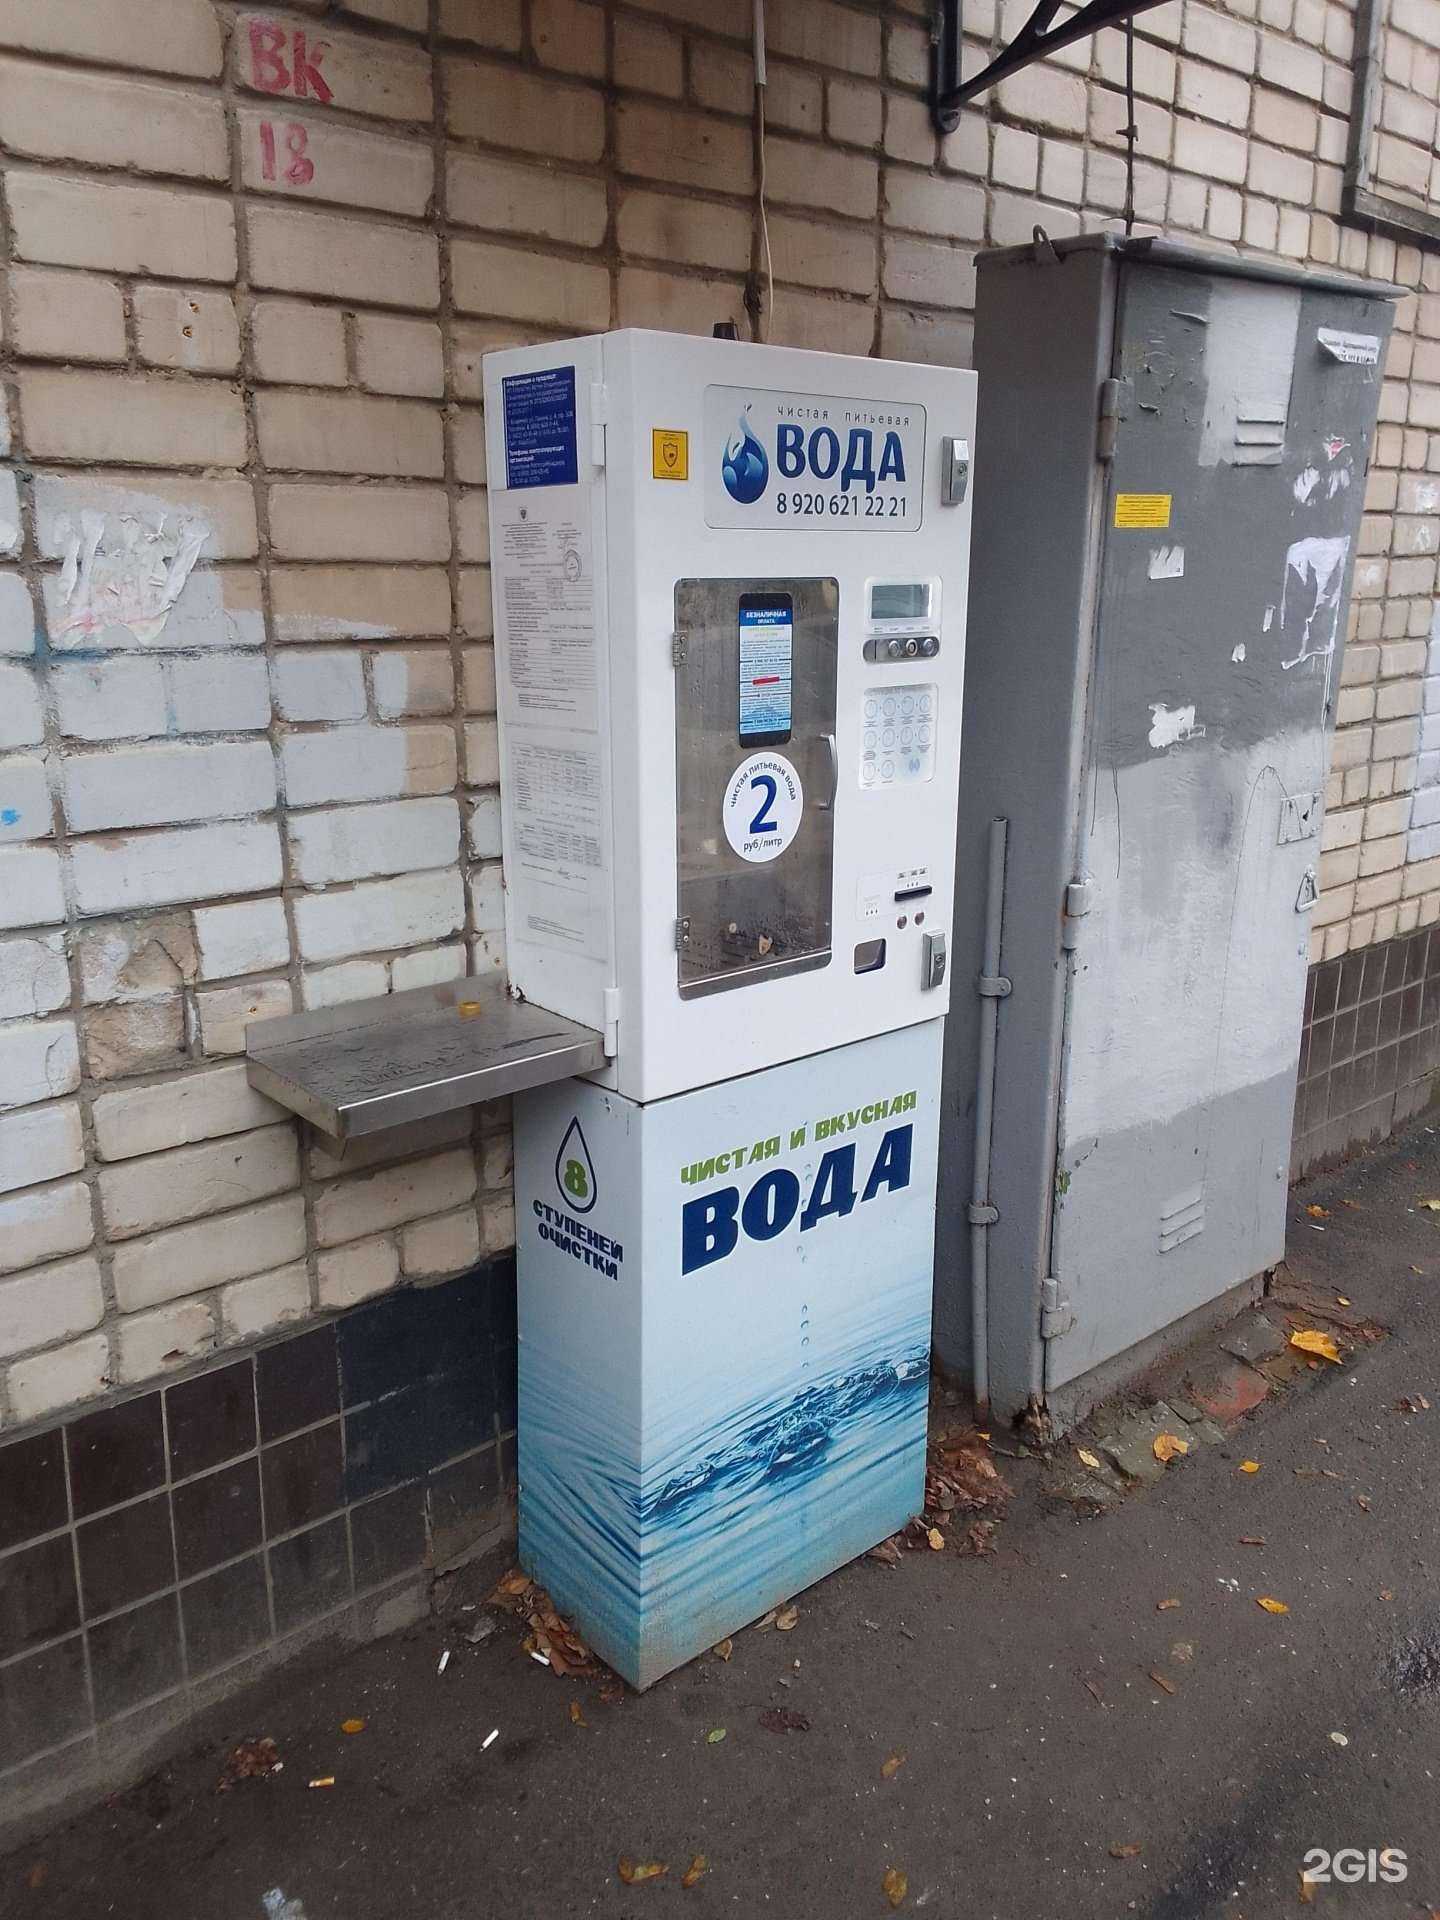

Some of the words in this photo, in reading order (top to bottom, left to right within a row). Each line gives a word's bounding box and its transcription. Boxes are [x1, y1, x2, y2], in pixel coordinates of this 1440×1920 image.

[260, 120, 314, 184] 18
[777, 406, 829, 420] чистая
[845, 412, 909, 426] питьевая
[776, 423, 906, 493] ВОДА
[776, 492, 787, 514] 8
[793, 493, 824, 515] 920
[829, 494, 858, 516] 621
[865, 496, 884, 517] 22
[889, 497, 906, 517] 21
[731, 772, 749, 808] чистая
[748, 762, 786, 777] питьевая
[784, 775, 796, 801] вода
[749, 774, 778, 834] 2
[681, 1135, 781, 1185] ЧИСТАЯ
[789, 1125, 806, 1150] И
[815, 1090, 917, 1143] ВКУСНАЯ
[564, 1159, 588, 1198] 8
[682, 1123, 913, 1276] ВОДА
[533, 1199, 623, 1263] СТУПЕНЕЙ
[538, 1222, 618, 1281] ОЧИСТКИ
